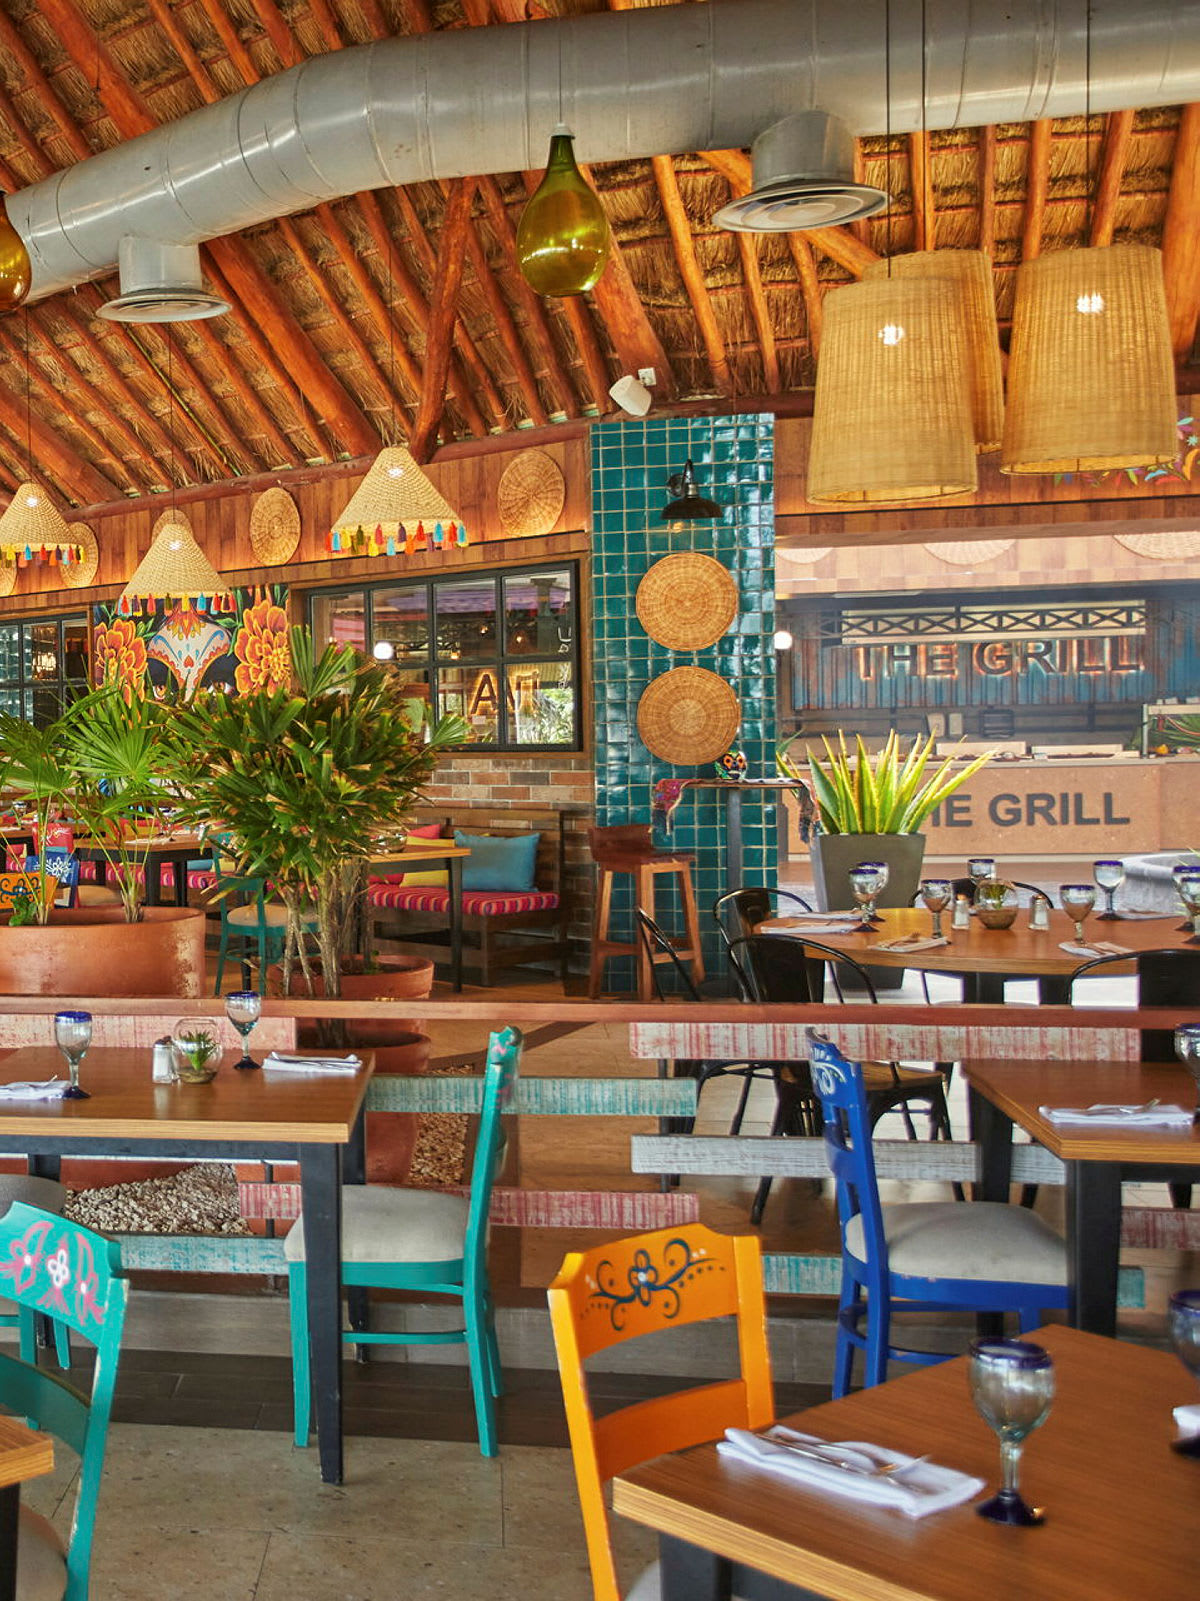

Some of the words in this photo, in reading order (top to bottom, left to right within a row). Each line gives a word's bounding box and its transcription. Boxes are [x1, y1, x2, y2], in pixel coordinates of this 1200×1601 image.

[855, 641, 957, 679] THE
[972, 637, 1145, 677] GRILL
[988, 792, 1131, 827] GRILL
